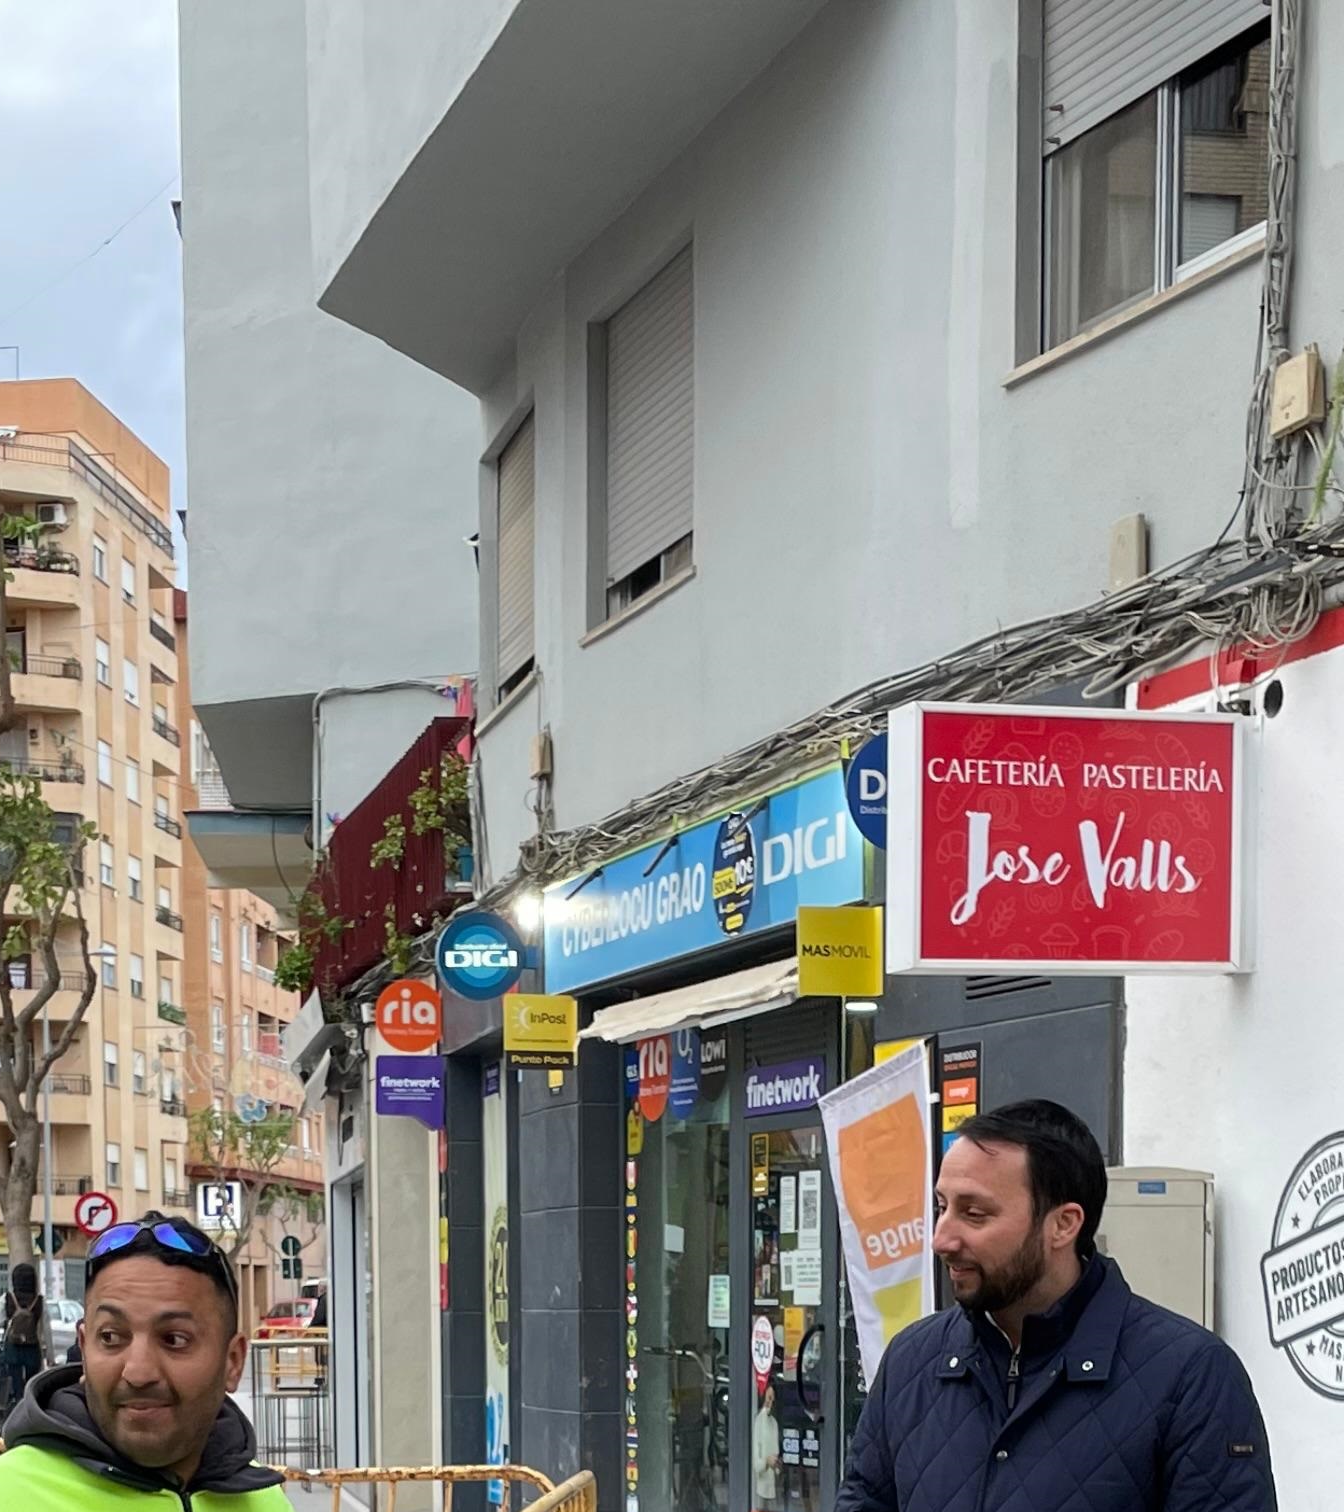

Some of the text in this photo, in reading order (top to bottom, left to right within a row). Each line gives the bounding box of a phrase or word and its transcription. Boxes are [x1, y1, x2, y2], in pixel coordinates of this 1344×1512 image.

[927, 755, 1224, 793] CAFETERÍA PASTELERÍA
[761, 812, 847, 886] DIGI
[950, 810, 1203, 926] Jose Valls
[656, 862, 706, 924] GRAO
[443, 950, 519, 969] DIGI
[382, 988, 437, 1025] ria
[529, 1012, 568, 1026] InPost
[639, 1038, 669, 1080] ria
[380, 1076, 441, 1089] finetwork
[745, 1065, 820, 1109] finetwork
